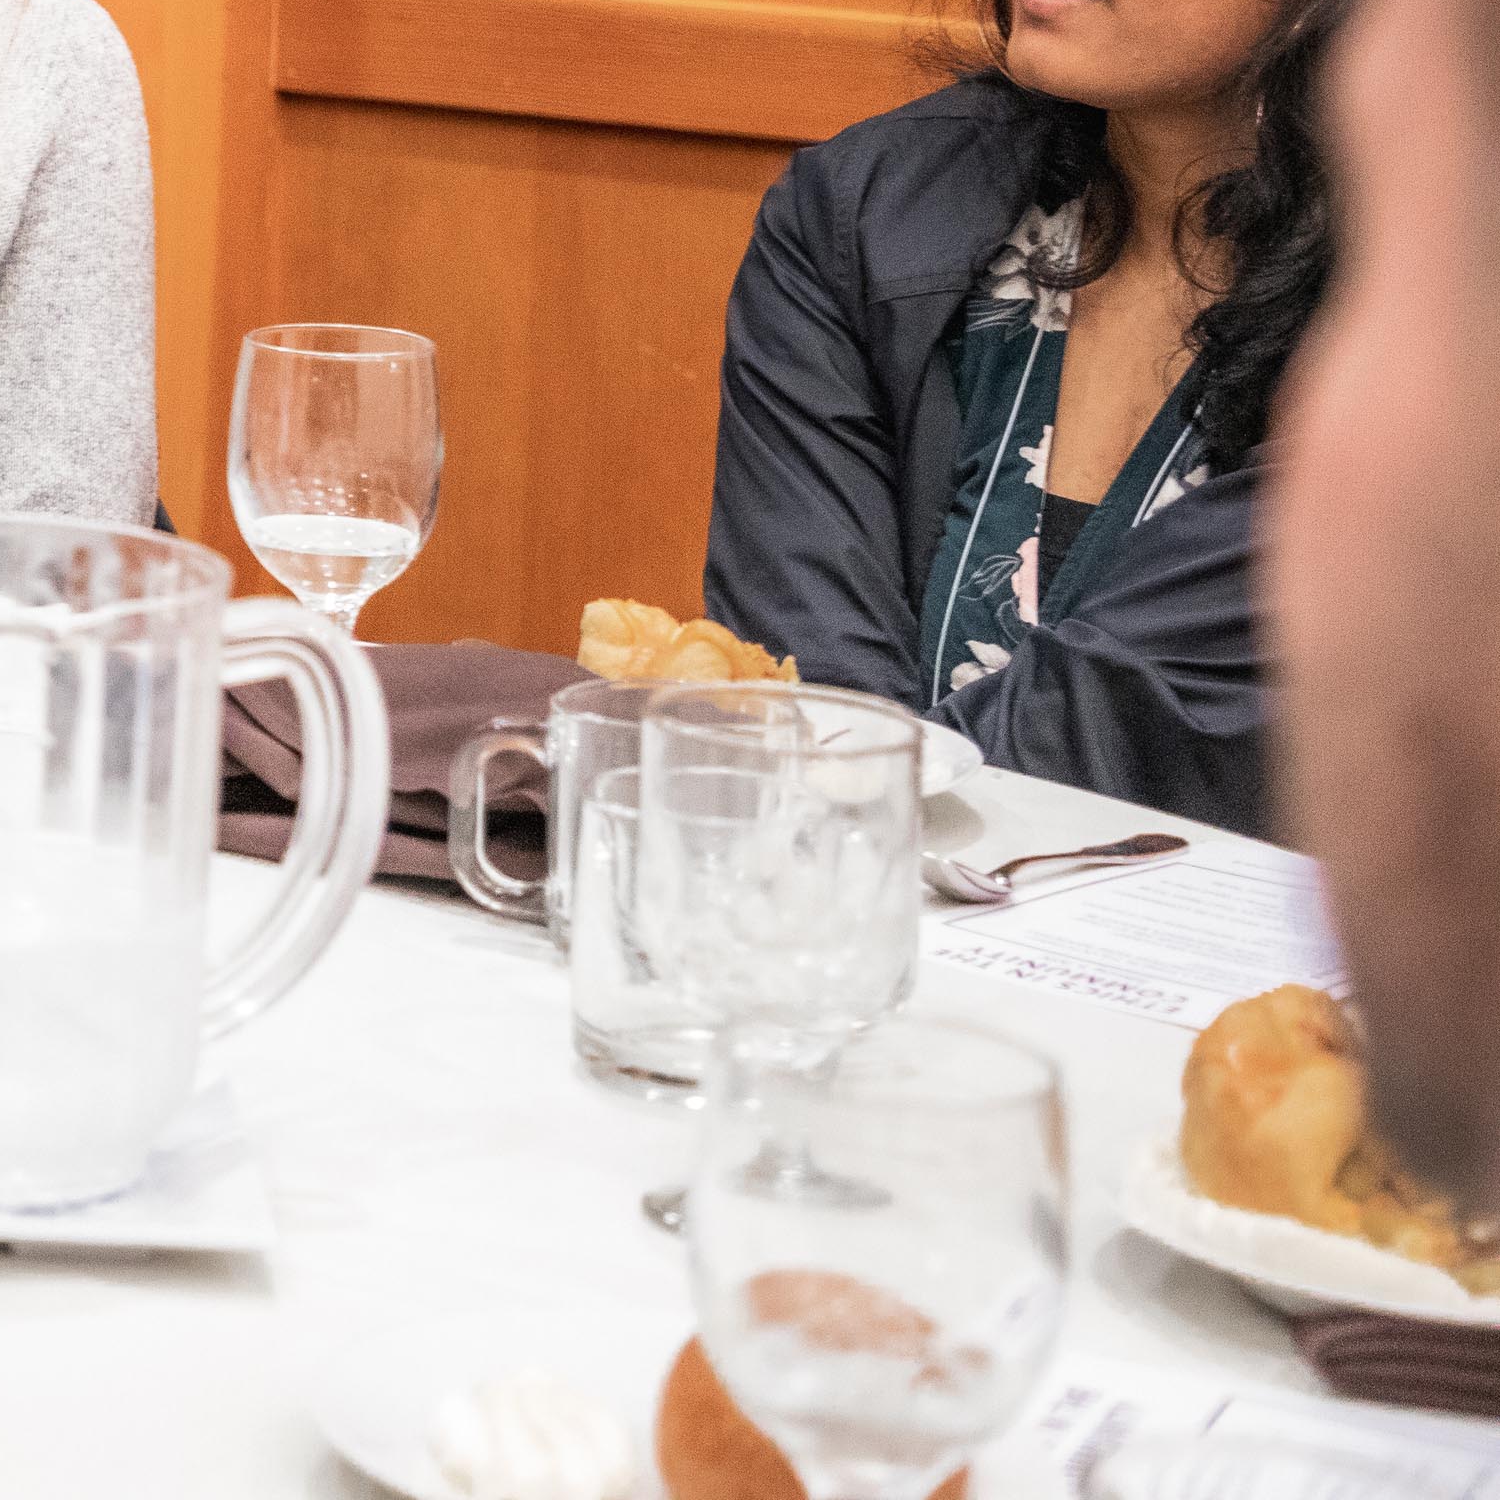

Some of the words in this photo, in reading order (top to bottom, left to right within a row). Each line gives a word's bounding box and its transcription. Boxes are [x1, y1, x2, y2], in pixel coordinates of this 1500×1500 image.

[934, 947, 993, 969] THE
[963, 945, 1190, 1005] COMMUNITY
[1004, 968, 1048, 984] IN
